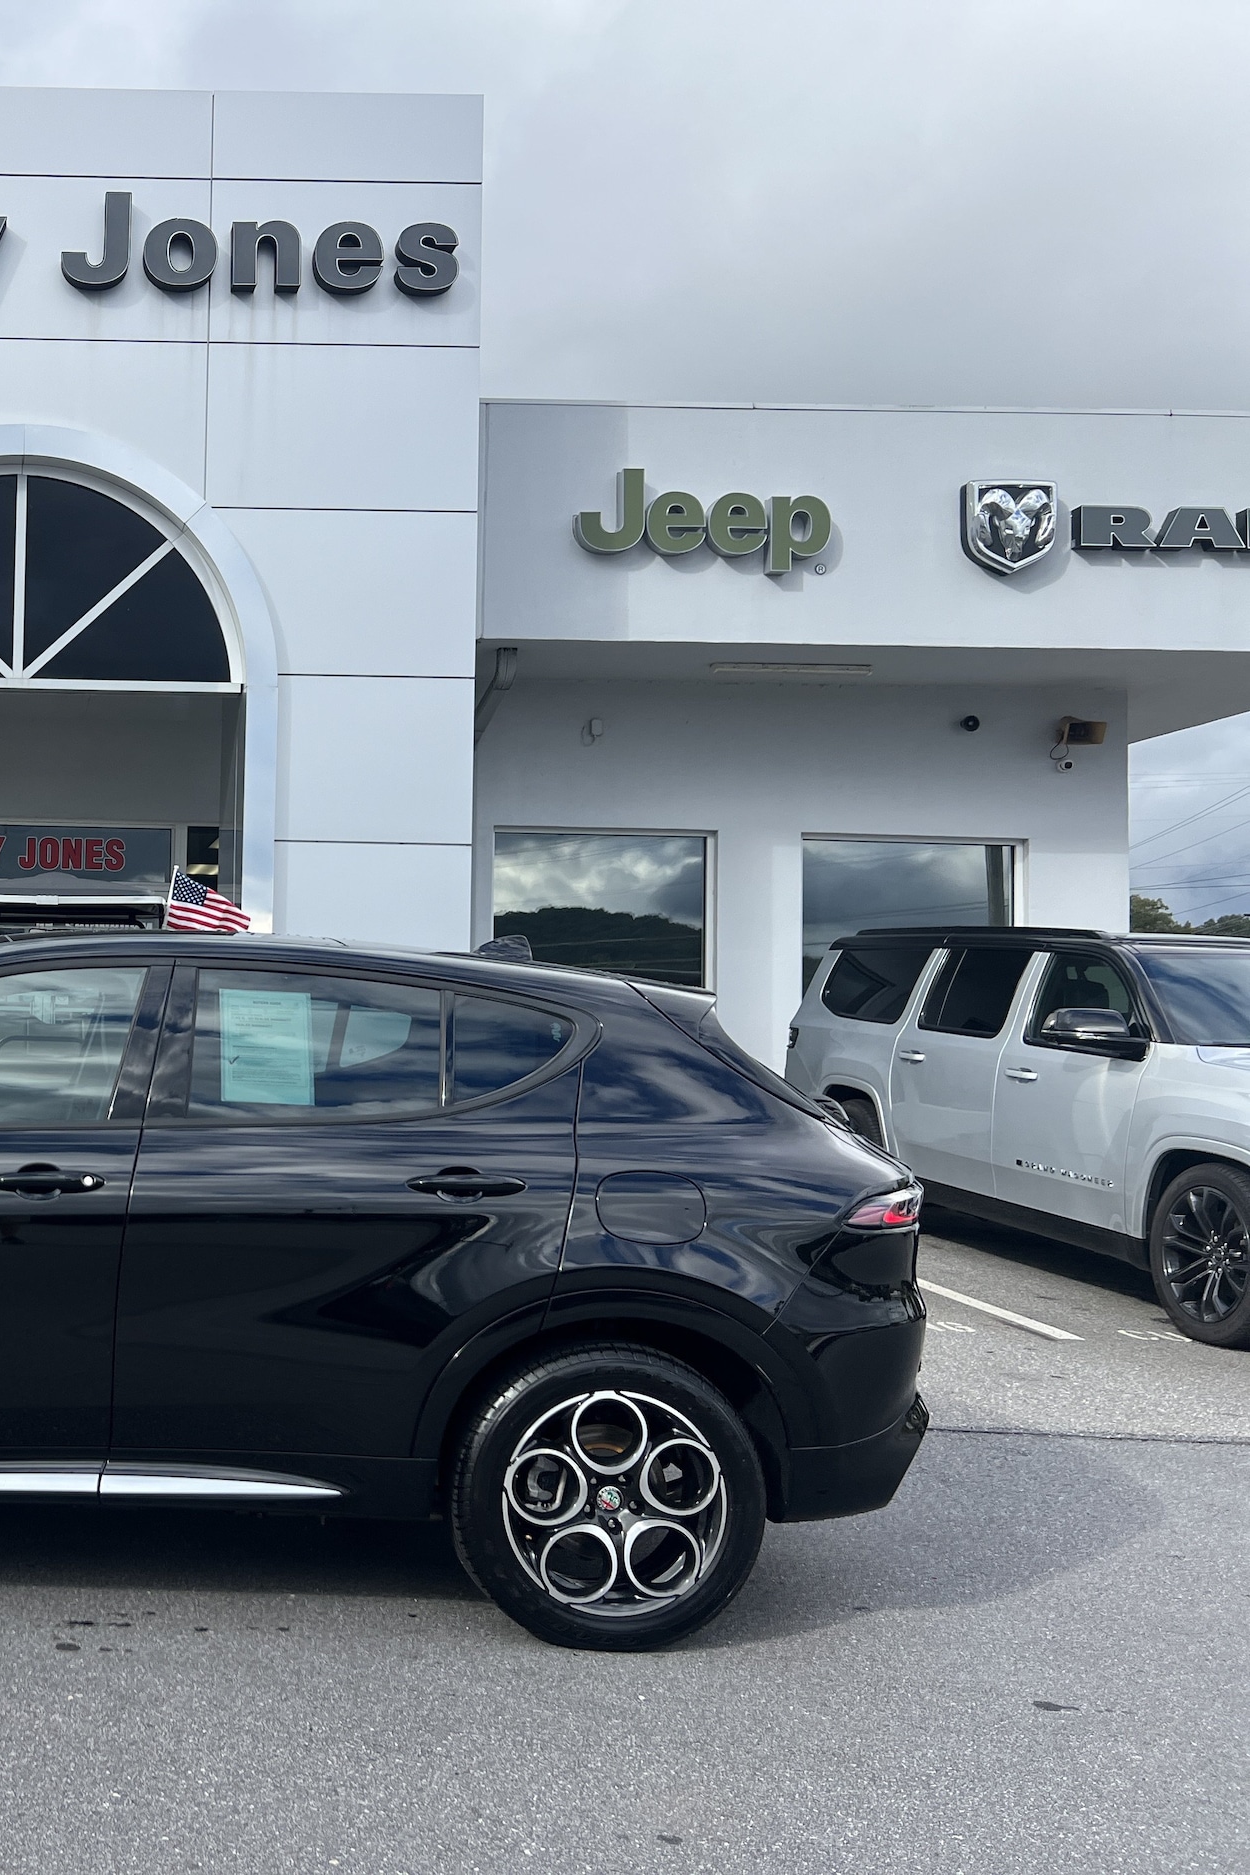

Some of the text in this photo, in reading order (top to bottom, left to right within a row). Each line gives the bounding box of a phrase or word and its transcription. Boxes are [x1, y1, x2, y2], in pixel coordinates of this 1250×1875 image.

[61, 191, 460, 297] Jones
[572, 468, 832, 576] Jeep
[1071, 505, 1250, 553] RA
[18, 836, 126, 872] JONES
